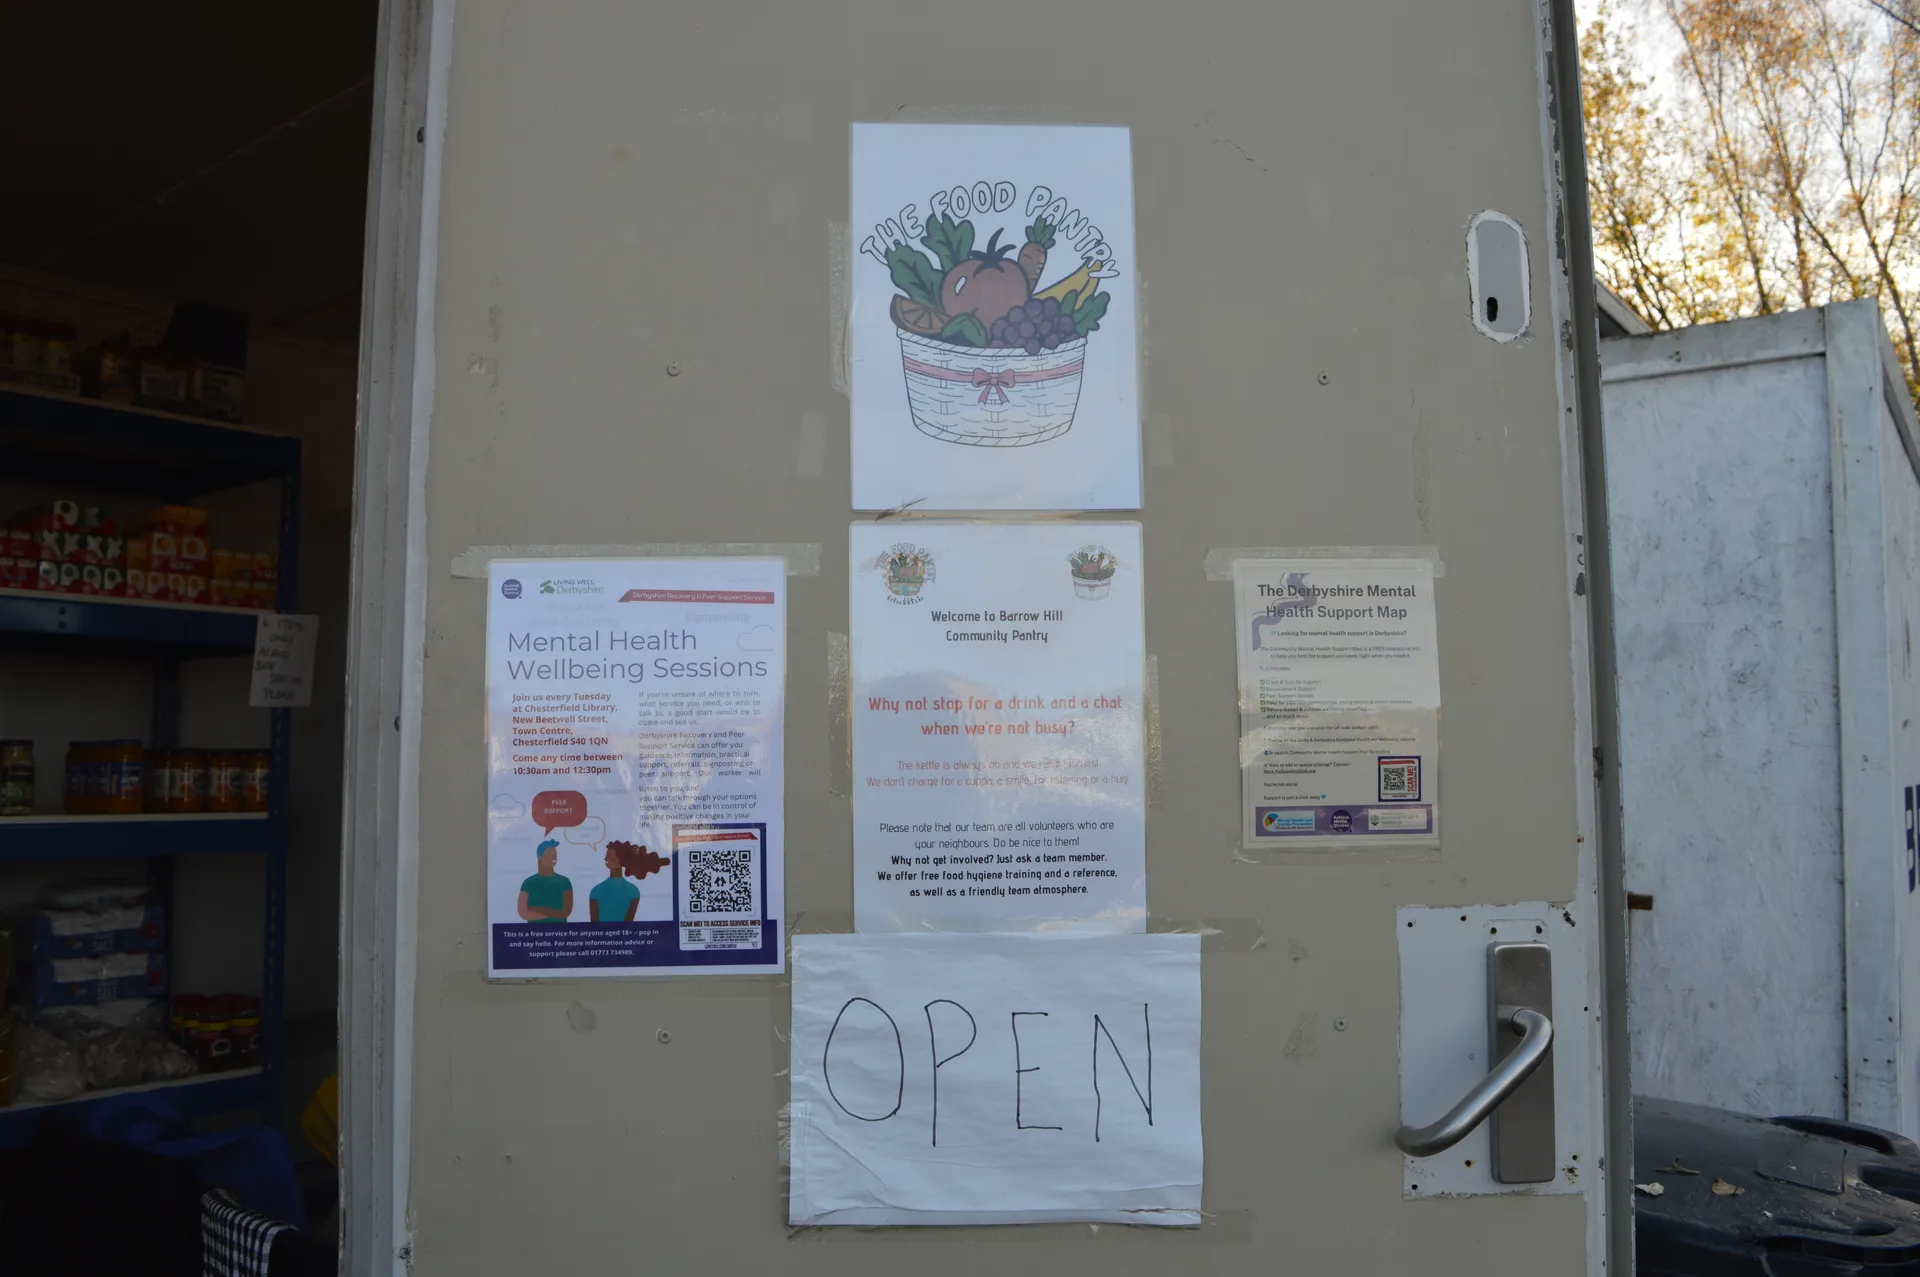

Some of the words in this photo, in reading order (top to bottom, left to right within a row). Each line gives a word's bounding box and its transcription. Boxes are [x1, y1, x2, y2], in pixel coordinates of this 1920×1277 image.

[860, 203, 925, 266] THE
[930, 181, 1016, 224] FOOD
[1025, 186, 1120, 278] PANTRY
[556, 585, 603, 594] Derbyshire
[1257, 584, 1283, 596] The
[1288, 584, 1363, 599] Derbyshire
[1367, 584, 1416, 596] Mental
[632, 592, 666, 600] Derbyshire
[666, 592, 695, 600] Recovery
[931, 610, 980, 621] Welcome
[984, 610, 995, 621] to
[999, 610, 1039, 621] Barrow
[1043, 610, 1062, 620] Hill
[1266, 606, 1313, 618] Health
[1317, 605, 1373, 620] Support
[1377, 605, 1407, 620] Map
[508, 630, 598, 652] Mental
[610, 629, 696, 650] Health
[946, 630, 1007, 643] Community
[1012, 630, 1048, 643] Pantry
[507, 657, 643, 683] Wellbeing
[653, 656, 767, 678] Sessions
[511, 693, 529, 702] Join
[545, 694, 571, 702] every
[573, 692, 610, 702] Tuesday
[524, 703, 580, 712] Chesterfield
[582, 703, 617, 713] Library,
[868, 696, 899, 714] Why
[905, 696, 926, 710] not
[932, 696, 965, 713] stop
[969, 696, 989, 709] for
[994, 699, 1002, 709] a
[1008, 695, 1044, 713] drink
[1050, 695, 1075, 708] and
[1080, 699, 1088, 708] a
[1094, 694, 1122, 708] chat
[535, 714, 574, 723] Beetwell
[576, 714, 607, 723] Street,
[539, 726, 572, 735] Centre,
[920, 721, 958, 735] when
[964, 721, 1002, 734] we're
[1007, 720, 1029, 734] not
[1035, 720, 1074, 736] busy?
[512, 737, 567, 746] Chesterfield
[570, 737, 585, 745] S40
[588, 737, 608, 746] 1QN
[512, 754, 538, 762] Come
[540, 755, 557, 763] any
[560, 753, 580, 761] time
[583, 752, 623, 760] between
[512, 766, 550, 774] 10:30am
[552, 766, 570, 774] and
[572, 765, 610, 775] 12:30pm
[879, 822, 909, 832] Please
[912, 822, 932, 832] note
[934, 822, 951, 832] that
[955, 824, 969, 832] our
[972, 822, 995, 831] team
[998, 823, 1012, 831] are
[1015, 821, 1025, 830] all
[1028, 821, 1074, 830] volunteers
[1077, 821, 1097, 829] who
[1099, 821, 1114, 829] are
[914, 840, 935, 850] your
[938, 838, 990, 850] neighbours.
[993, 837, 1006, 847] Do
[1008, 837, 1019, 847] be
[1022, 837, 1040, 847] nice
[1043, 837, 1052, 846] to
[1054, 836, 1079, 846] them!
[891, 855, 911, 866] Why
[915, 855, 929, 864] not
[933, 855, 946, 866] get
[950, 854, 993, 864] involved?
[996, 854, 1012, 863] Just
[1015, 854, 1031, 863] ask
[1043, 853, 1065, 862] team
[1068, 853, 1106, 861] member.
[877, 871, 891, 880] We
[895, 871, 917, 880] offer
[921, 870, 939, 880] free
[942, 870, 963, 880] food
[966, 870, 1002, 881] hygiene
[1005, 869, 1041, 880] training
[1044, 869, 1061, 877] and
[1073, 869, 1117, 877] reference,
[923, 886, 942, 896] well
[968, 886, 1004, 897] friendly
[1008, 885, 1030, 894] team
[1033, 885, 1088, 896] atmosphere.
[750, 919, 762, 927] INFO
[824, 997, 1153, 1147] OPEN
